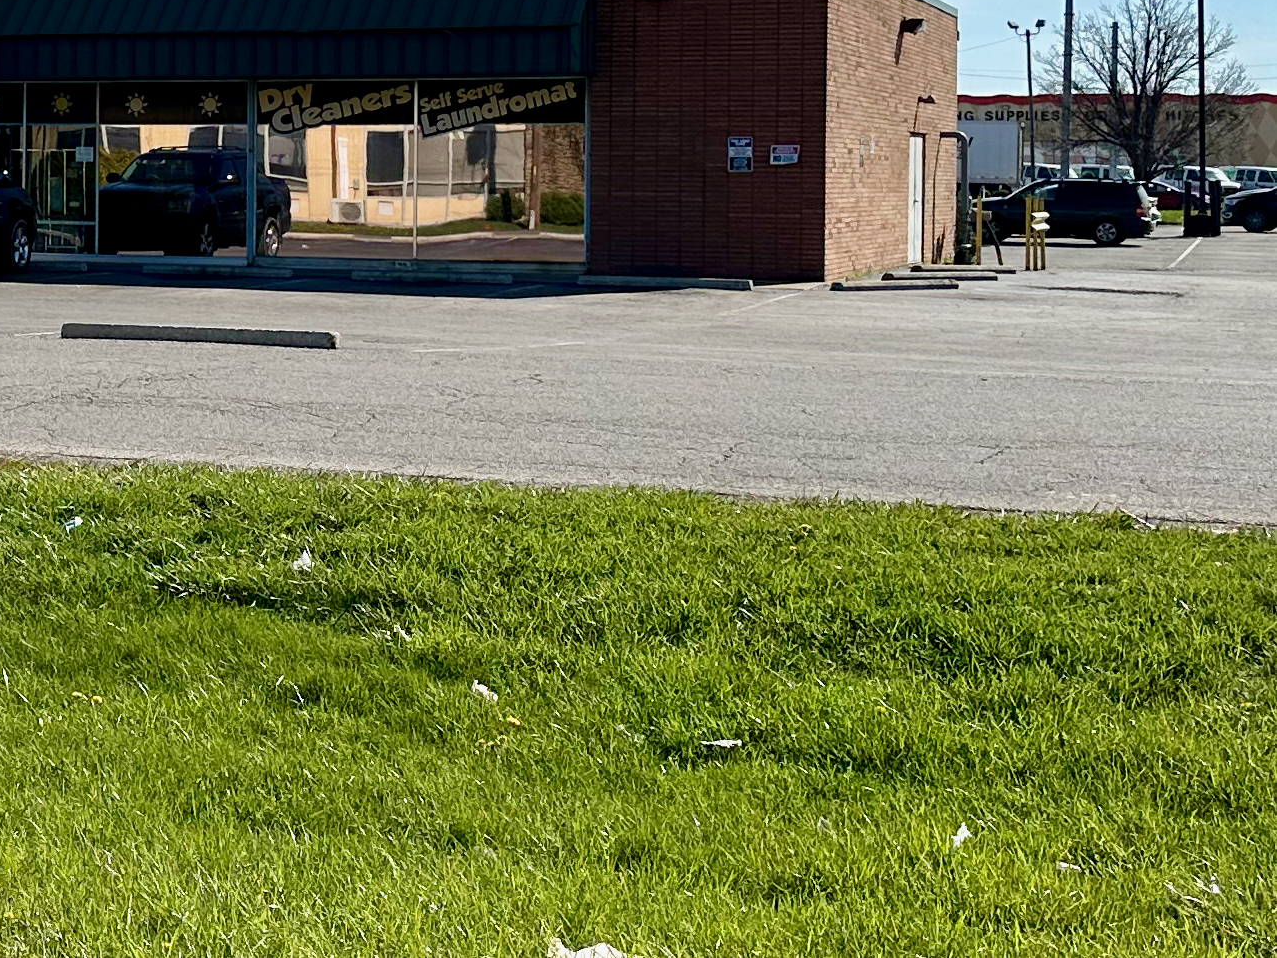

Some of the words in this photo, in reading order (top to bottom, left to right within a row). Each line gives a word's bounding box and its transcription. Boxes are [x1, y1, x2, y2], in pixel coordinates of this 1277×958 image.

[258, 83, 313, 113] Dry
[272, 84, 412, 132] Cleaners
[420, 91, 452, 113] Self
[456, 82, 505, 104] Serve
[420, 81, 577, 135] Laundromat
[985, 110, 1060, 121] SUPPLIES
